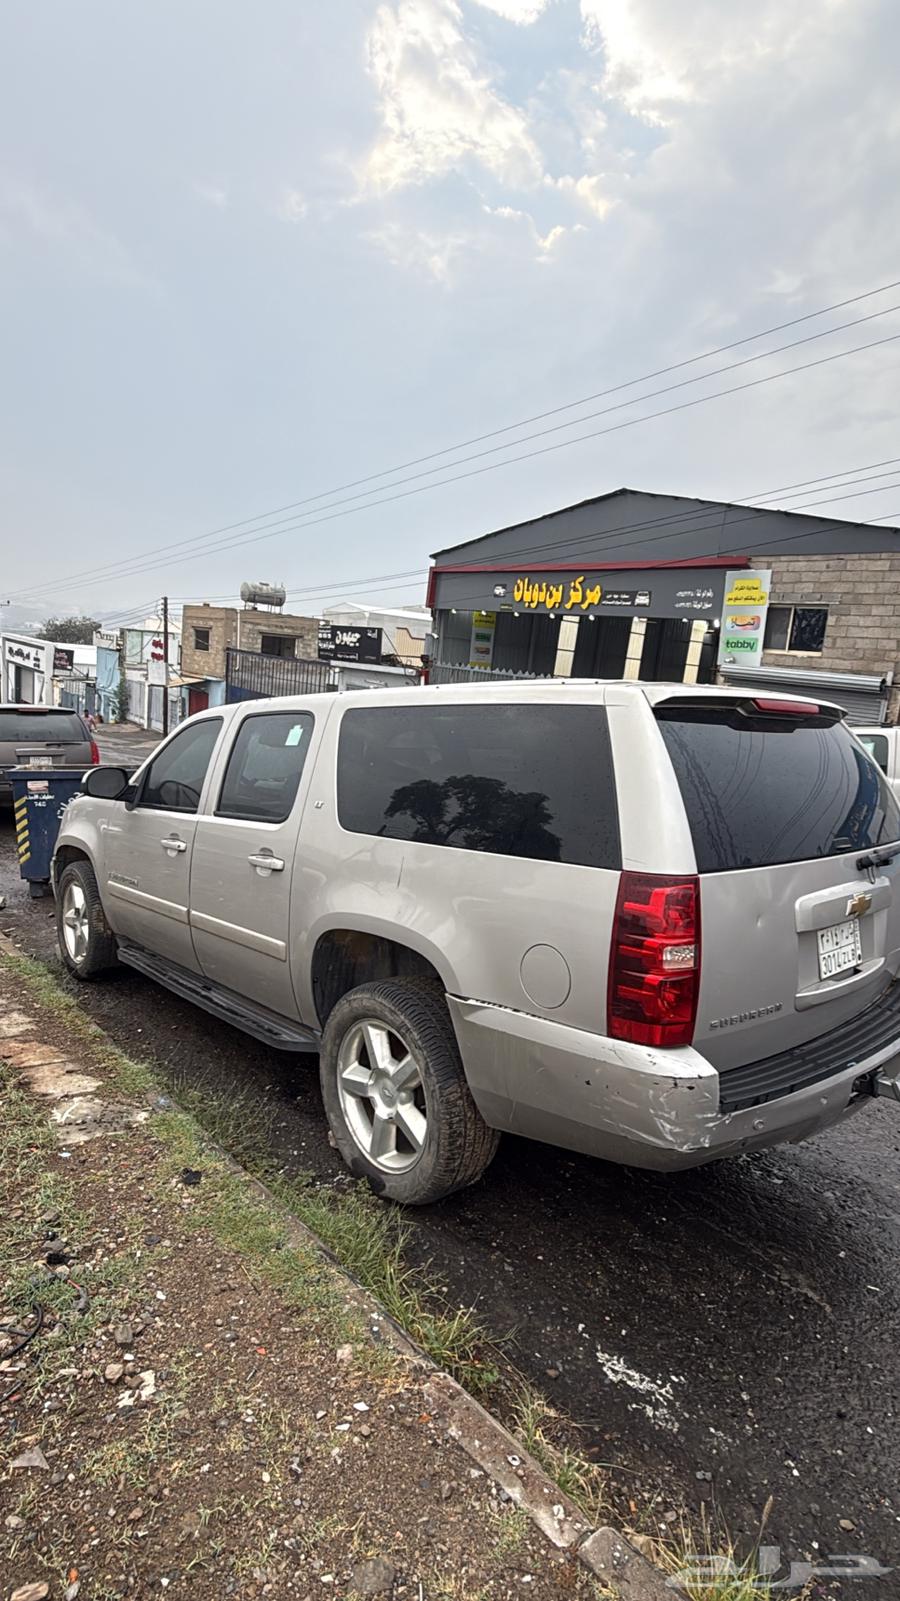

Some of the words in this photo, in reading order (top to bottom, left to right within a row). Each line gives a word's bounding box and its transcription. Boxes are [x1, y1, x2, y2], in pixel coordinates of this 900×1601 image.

[545, 584, 563, 609] بن
[564, 575, 602, 610] مركز
[726, 639, 755, 651] tabby
[822, 951, 841, 976] 3014
